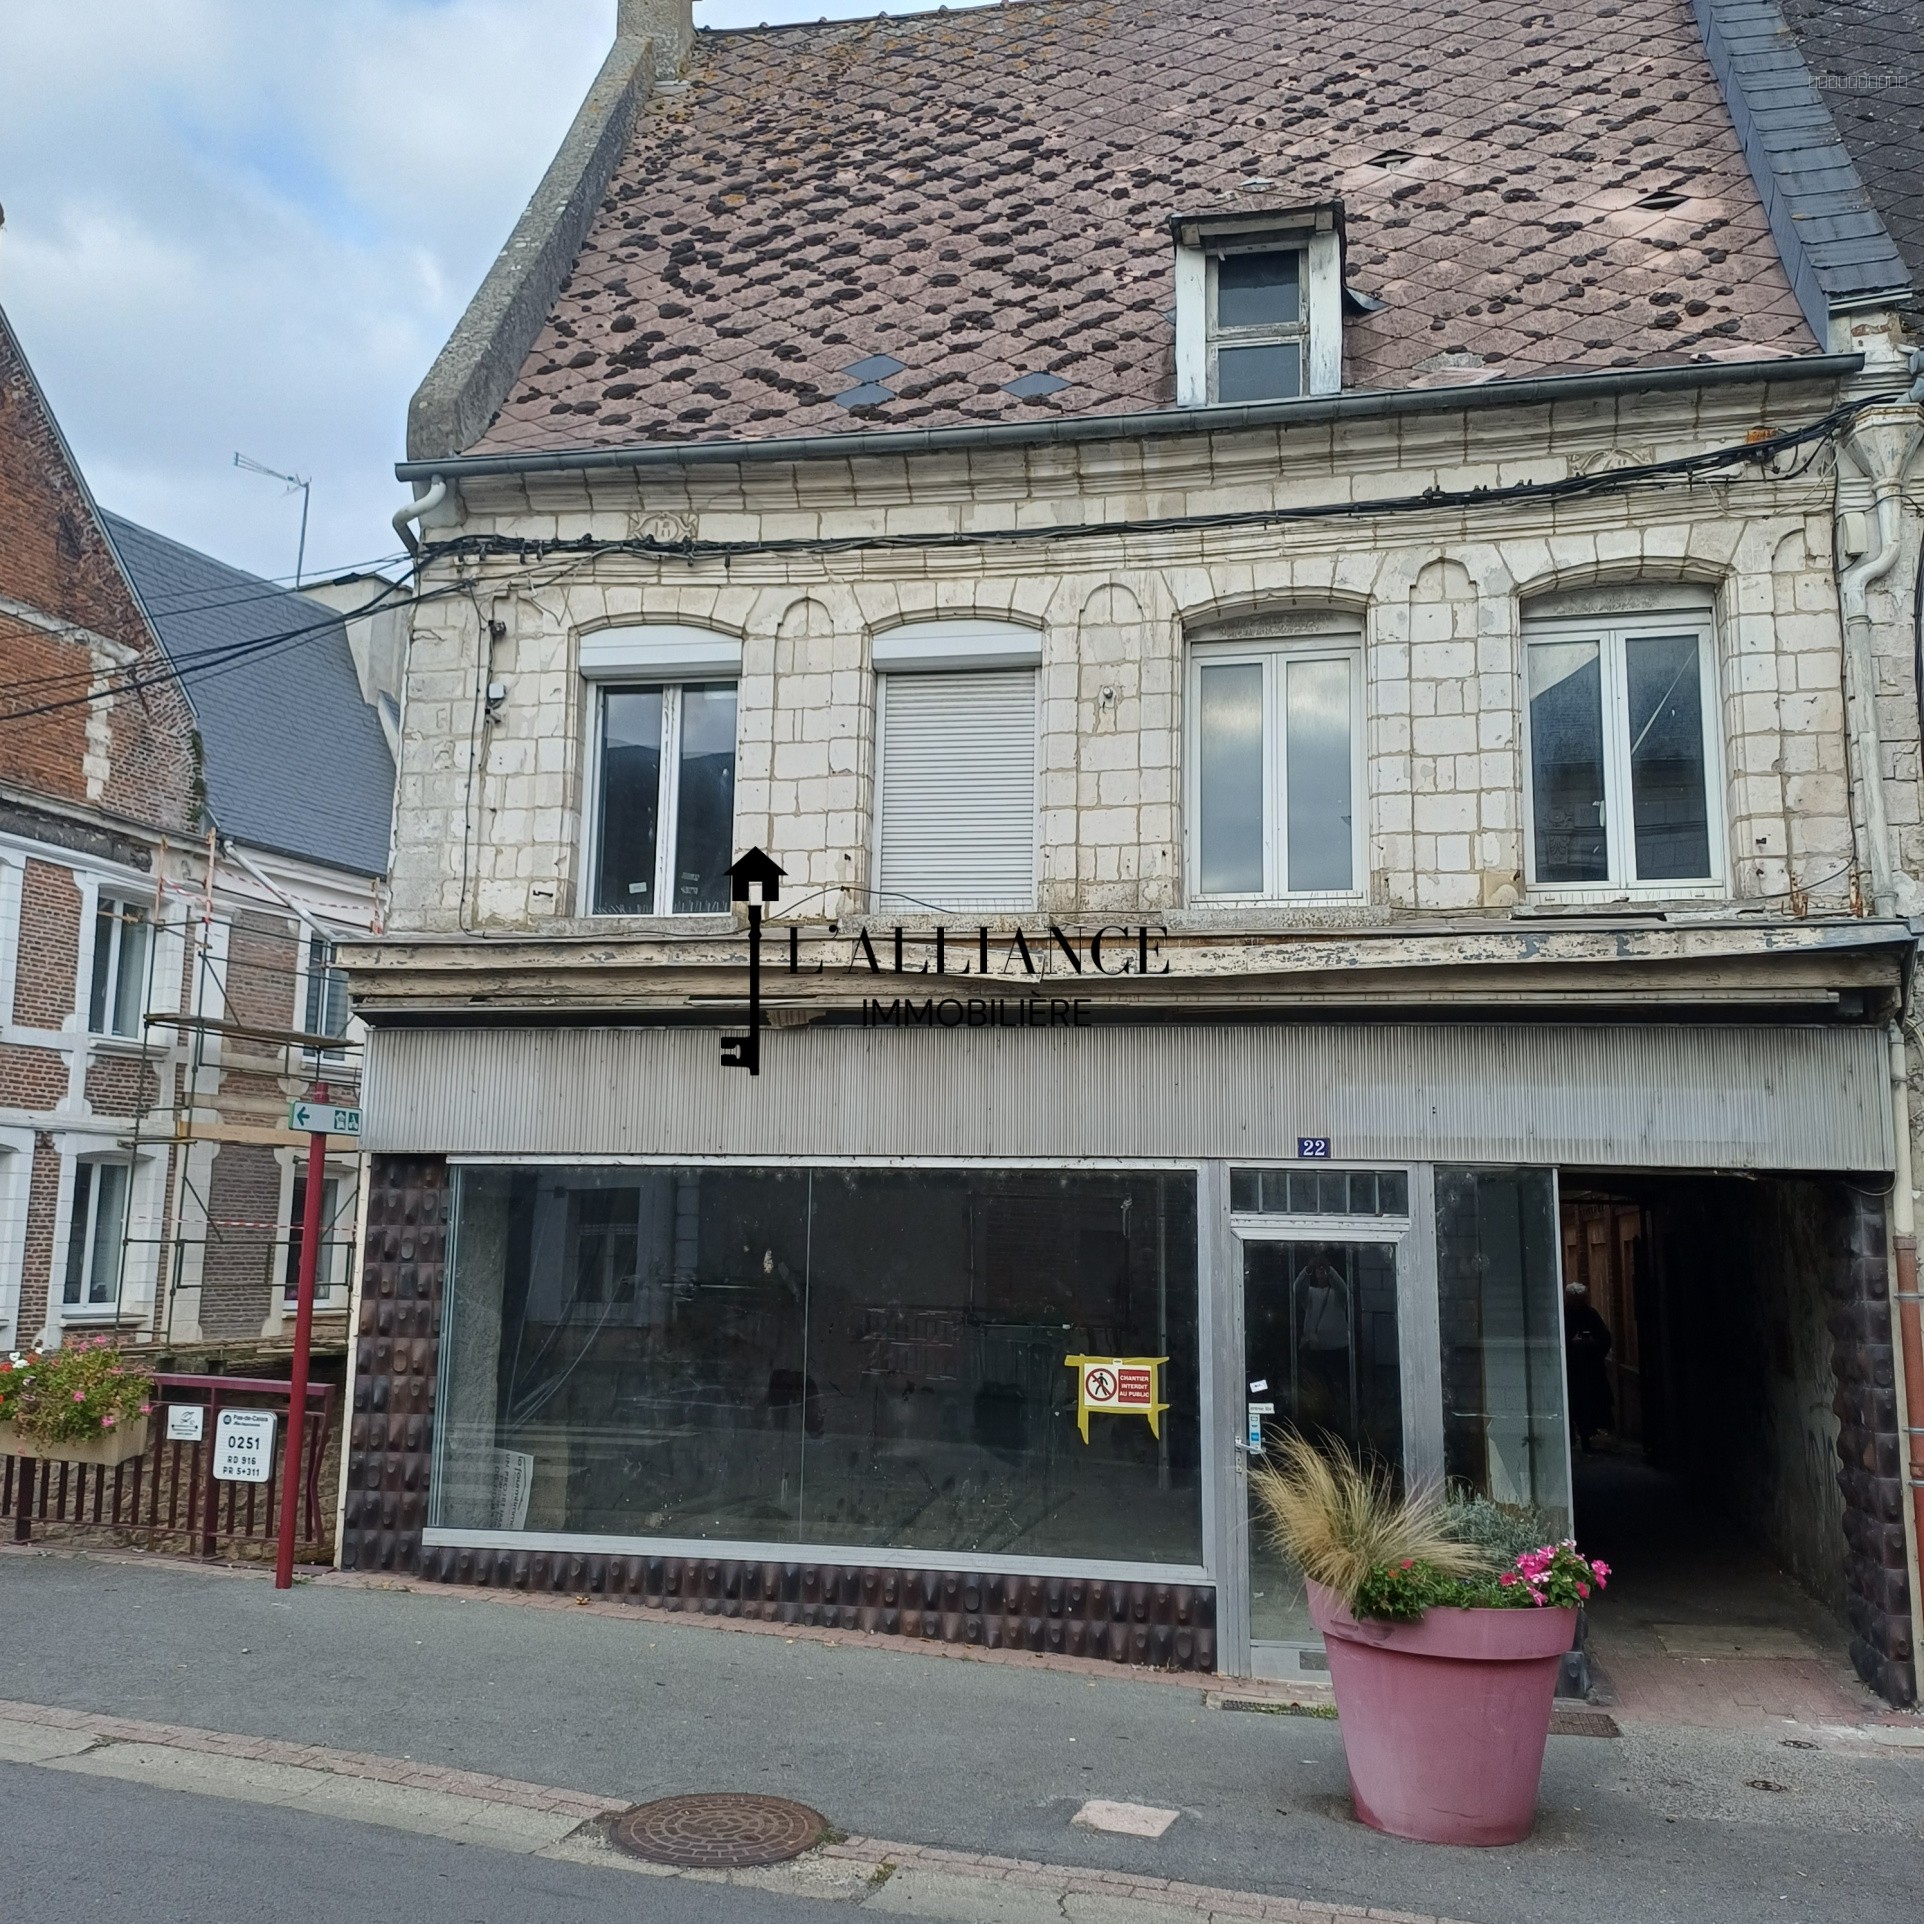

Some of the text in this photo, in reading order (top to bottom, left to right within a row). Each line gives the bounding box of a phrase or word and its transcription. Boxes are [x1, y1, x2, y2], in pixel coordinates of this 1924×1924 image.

[1303, 1139, 1326, 1156] 22
[233, 1414, 269, 1422] Pas-de-Calais
[228, 1435, 260, 1450] 0251
[227, 1455, 257, 1465] RD 916
[222, 1466, 260, 1477] PR 5+311
